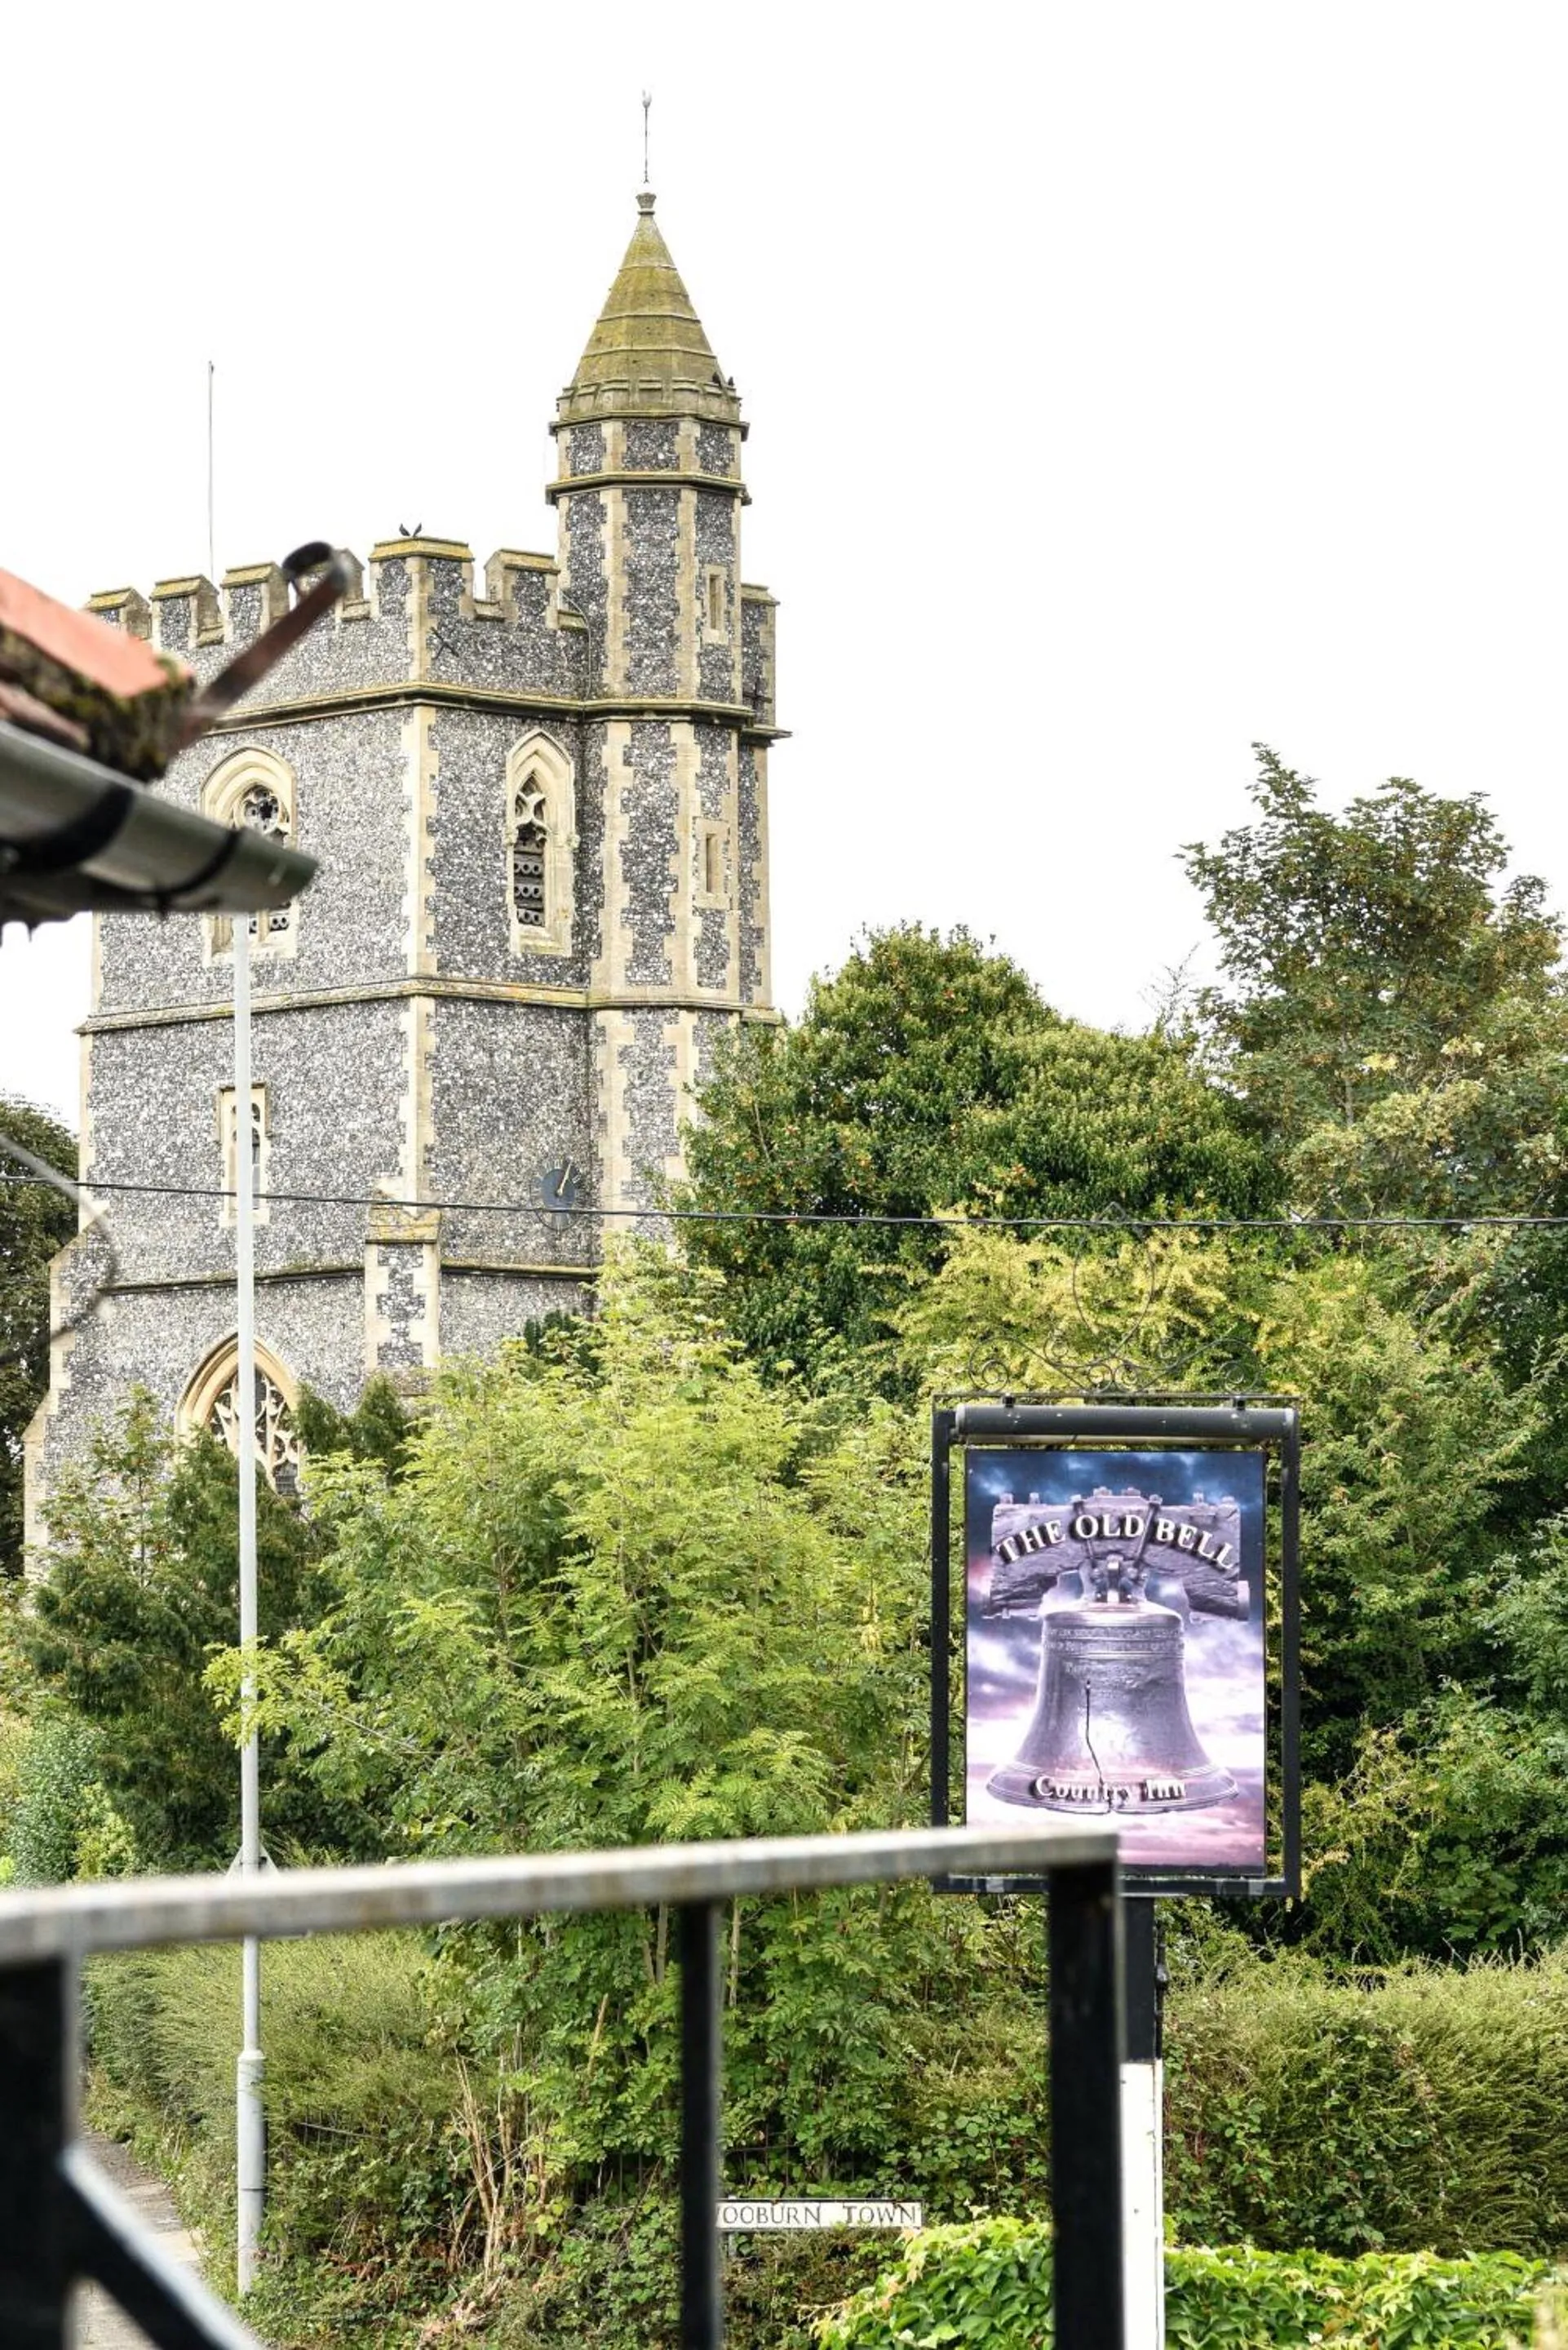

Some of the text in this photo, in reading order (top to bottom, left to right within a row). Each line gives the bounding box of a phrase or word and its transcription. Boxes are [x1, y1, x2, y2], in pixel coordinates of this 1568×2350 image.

[994, 1514, 1234, 1570] THE OLD BELL
[1034, 1774, 1186, 1807] Country Inn
[717, 2205, 916, 2224] OOBURN TOWN
